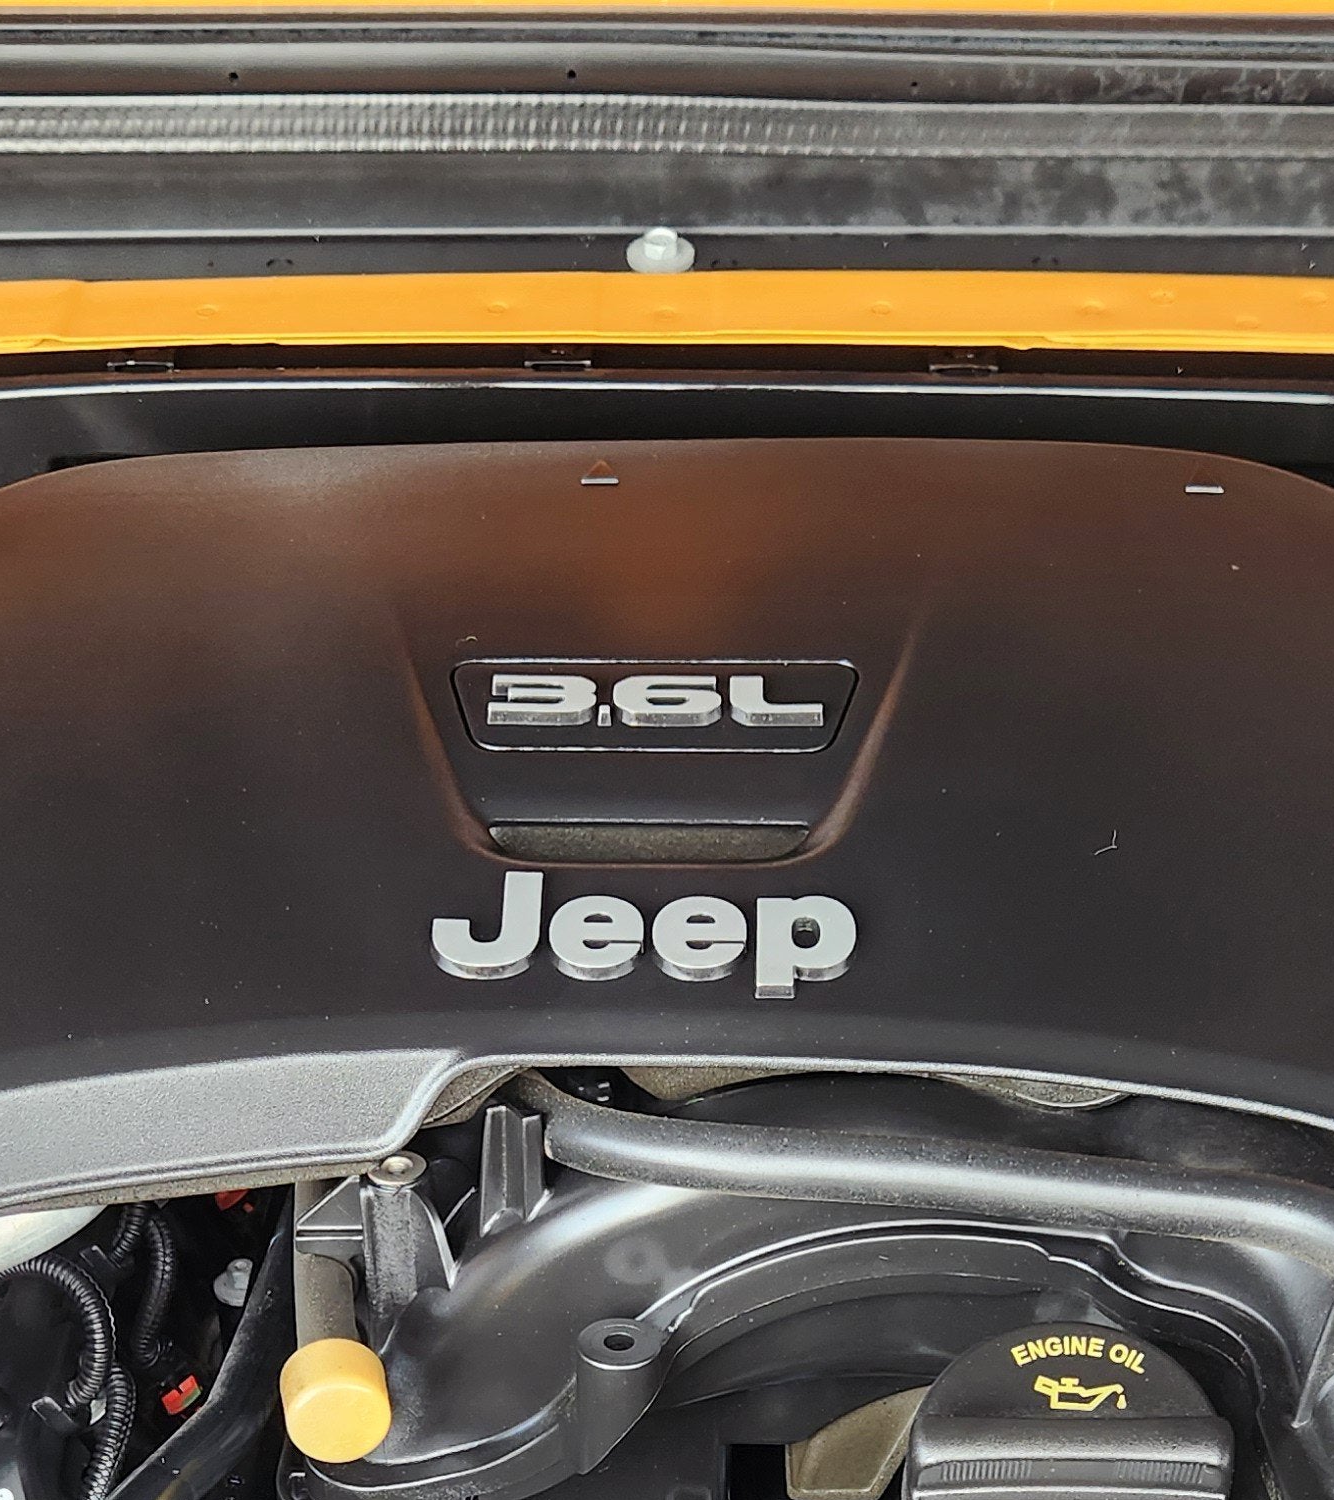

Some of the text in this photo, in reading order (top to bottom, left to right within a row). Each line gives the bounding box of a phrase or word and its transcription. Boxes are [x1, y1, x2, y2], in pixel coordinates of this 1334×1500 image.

[486, 674, 824, 728] 3.6L
[431, 871, 857, 999] Jeep
[1011, 1336, 1145, 1374] ENGINE OIL
